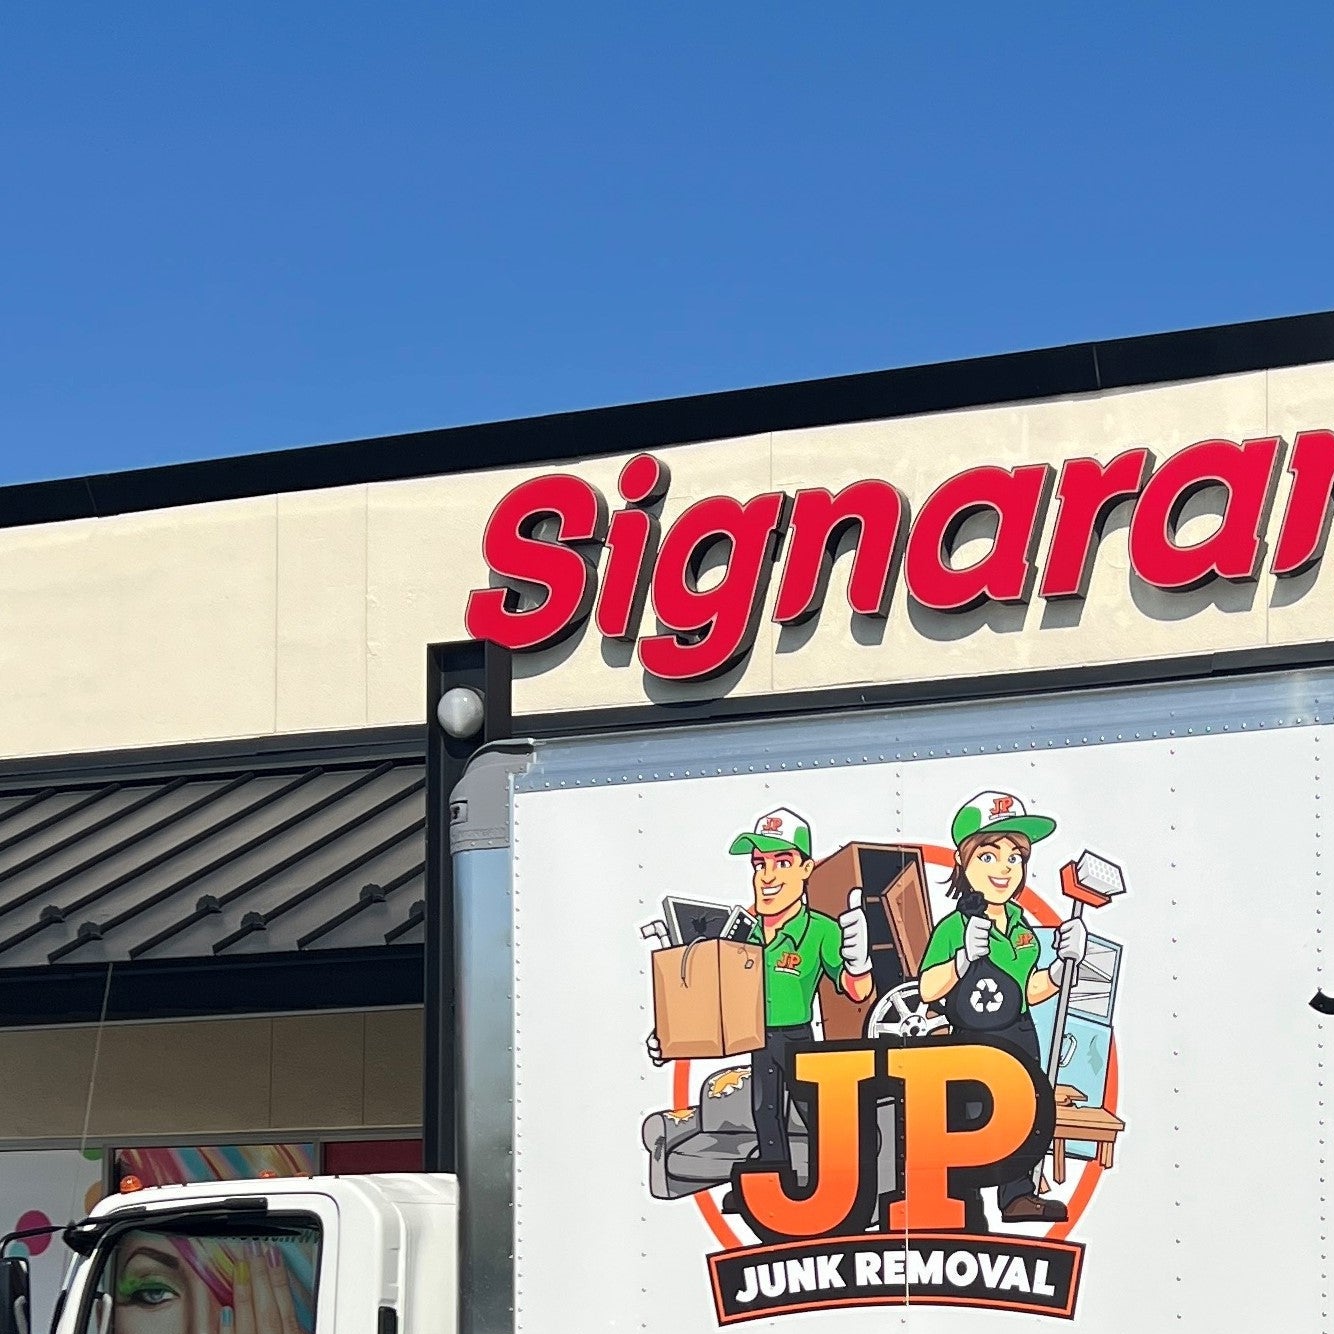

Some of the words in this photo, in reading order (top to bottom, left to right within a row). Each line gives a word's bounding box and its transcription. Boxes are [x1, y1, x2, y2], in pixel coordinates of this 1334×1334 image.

[739, 1044, 1037, 1237] JP
[735, 1253, 847, 1303] JUNK
[855, 1250, 1056, 1297] REMOVAL
